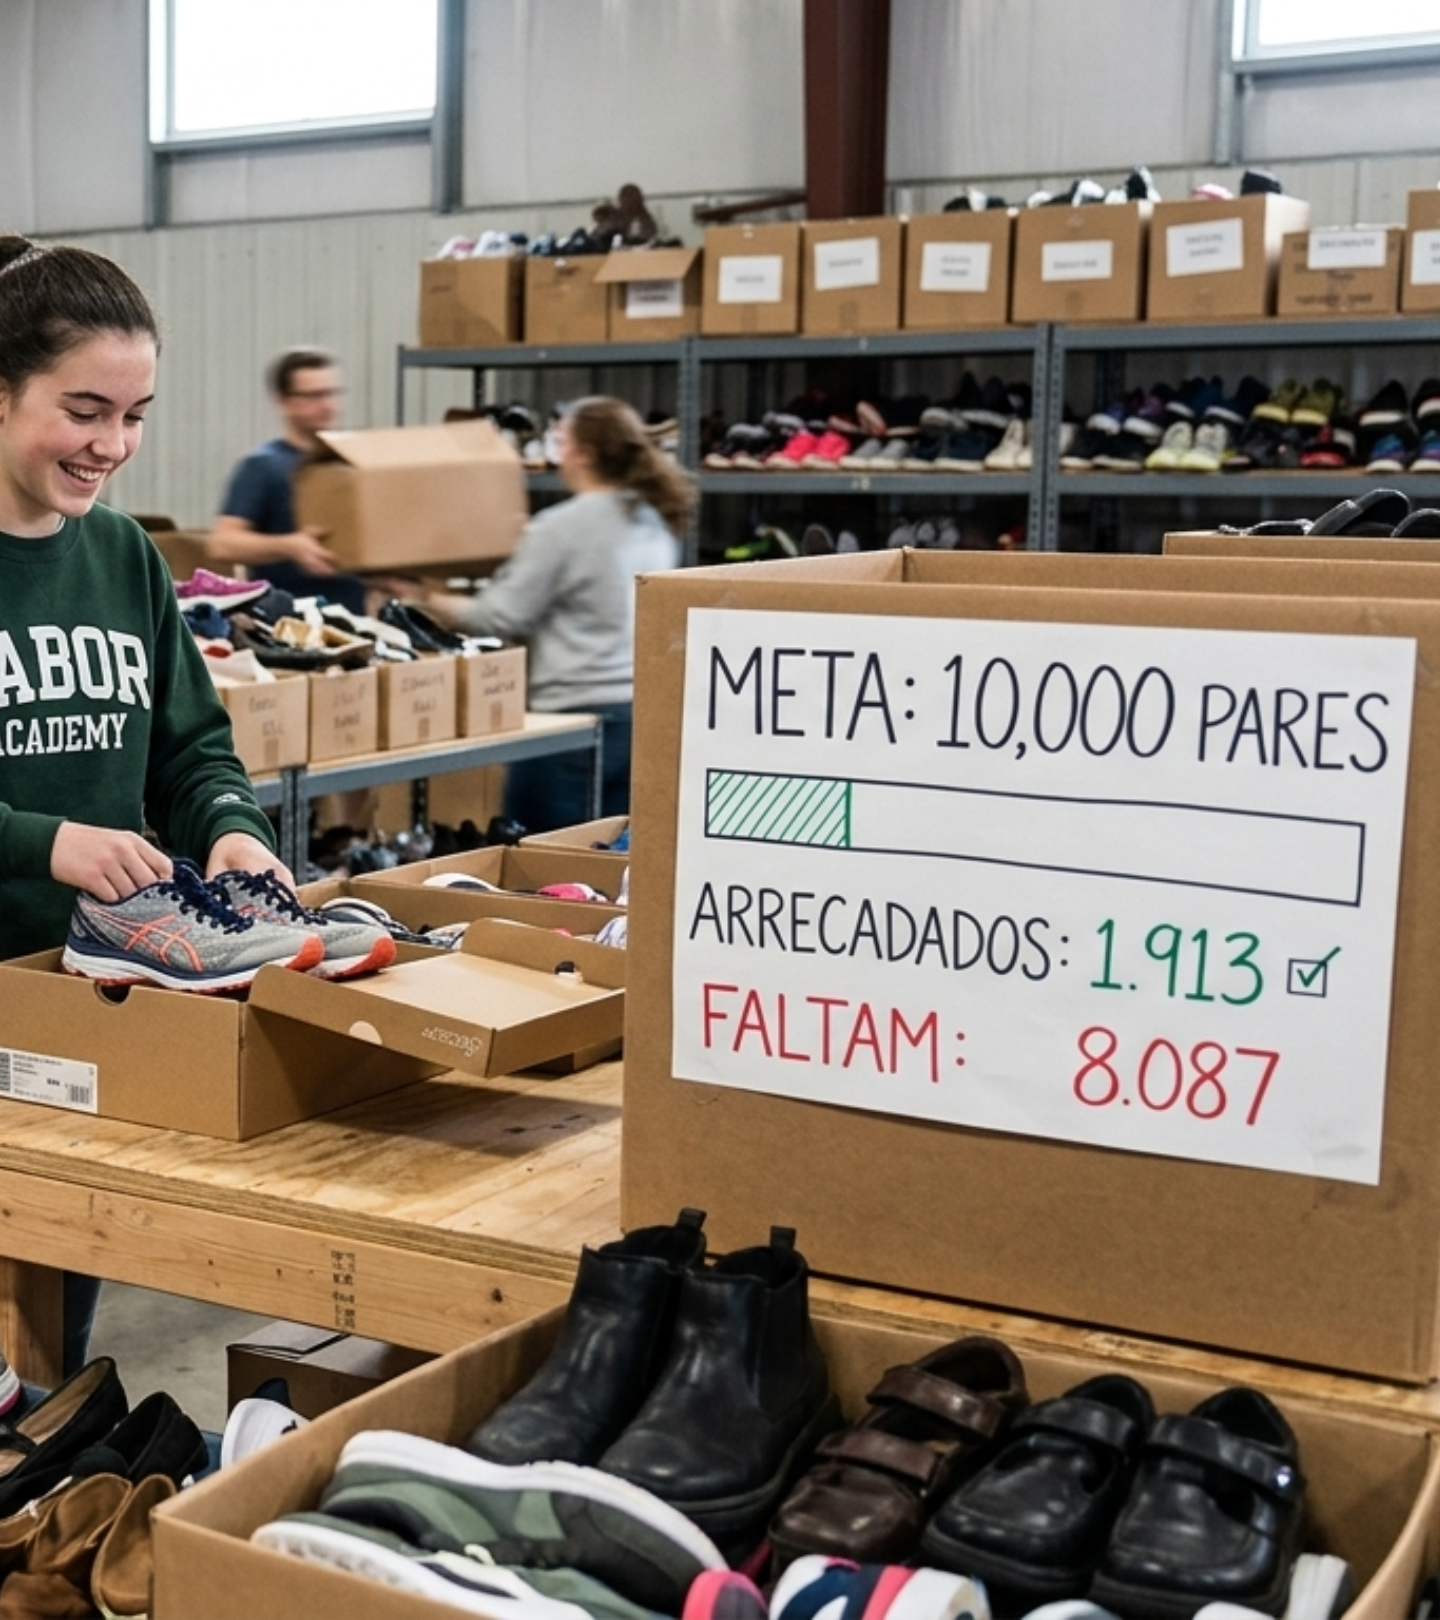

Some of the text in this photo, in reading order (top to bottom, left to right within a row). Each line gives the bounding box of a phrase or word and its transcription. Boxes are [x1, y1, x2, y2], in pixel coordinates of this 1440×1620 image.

[708, 646, 1389, 773] META: 10,000 PARES
[689, 881, 1264, 1006] ARRECADADOS: 1.913
[702, 982, 1281, 1127] FALTAM: 8.087
